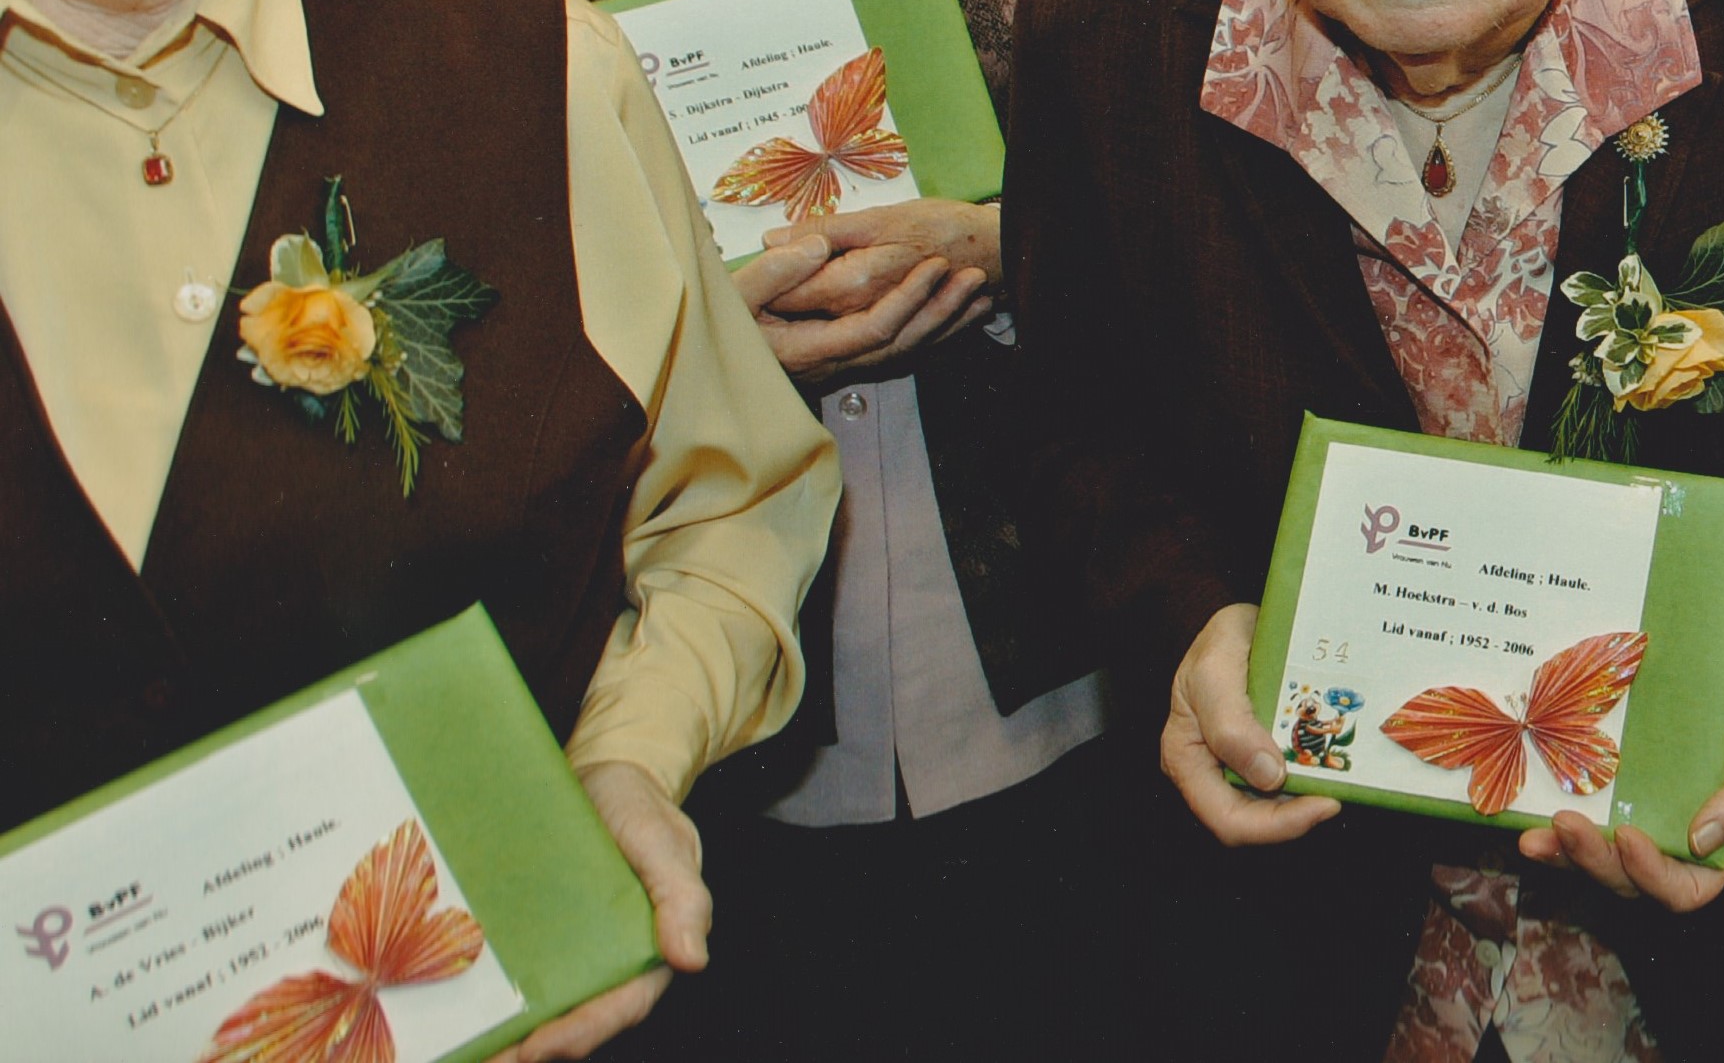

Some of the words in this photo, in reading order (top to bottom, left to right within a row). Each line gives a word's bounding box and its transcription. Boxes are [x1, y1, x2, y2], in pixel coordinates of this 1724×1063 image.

[669, 50, 705, 68] BvPF
[741, 51, 789, 70] Afdeling
[797, 39, 833, 55] Haule.
[686, 96, 734, 115] Dijkstra
[742, 80, 790, 99] Dijkstra
[688, 130, 709, 145] Lid
[710, 122, 744, 138] vanaf
[753, 112, 780, 127] 1945
[789, 103, 808, 117] 200
[1408, 524, 1450, 542] BvPF
[1478, 564, 1536, 586] Afdeling
[1548, 573, 1592, 592] Haule.
[1373, 582, 1391, 597] M.
[1396, 586, 1456, 608] Hoekstra
[1471, 600, 1483, 612] v.
[1486, 601, 1500, 615] d.
[1504, 604, 1528, 619] Bos
[1382, 621, 1405, 636] Lid
[1409, 628, 1447, 644] vanaf
[1459, 633, 1490, 650] 1952
[1502, 640, 1535, 657] 2006
[202, 851, 276, 896] Afdeling
[87, 880, 143, 919] BvPF
[114, 968, 134, 988] de
[139, 944, 187, 974] Vries
[202, 906, 256, 943] Bijker
[127, 1004, 160, 1030] Lid
[163, 971, 213, 1009] vanaf
